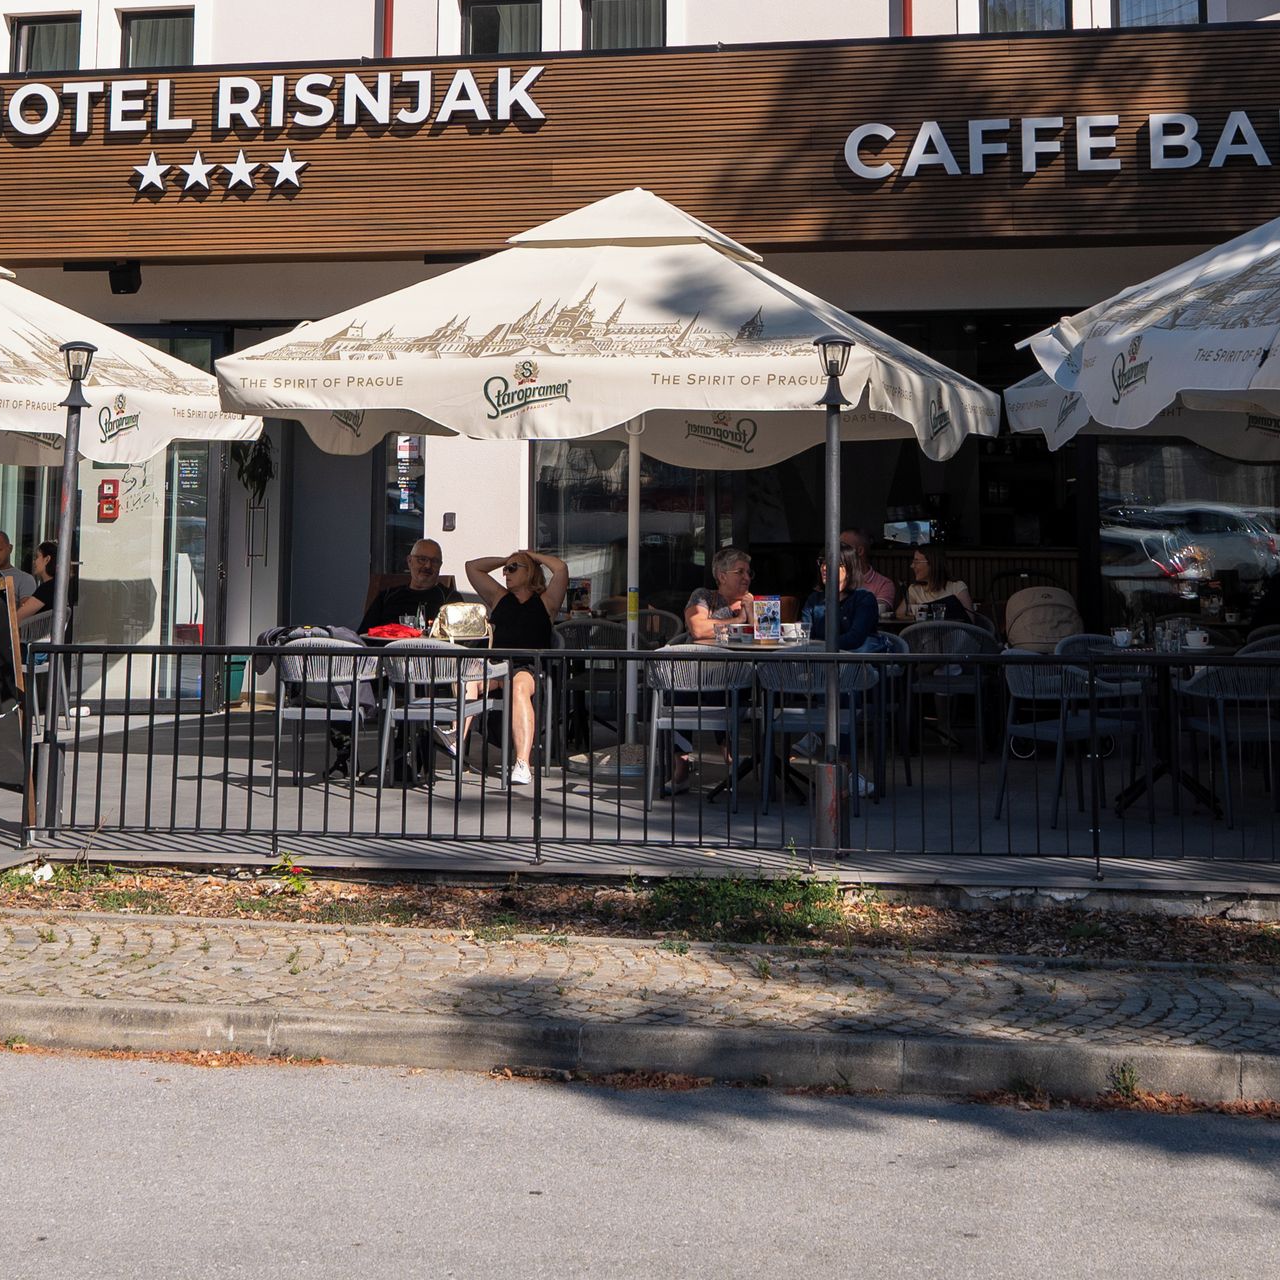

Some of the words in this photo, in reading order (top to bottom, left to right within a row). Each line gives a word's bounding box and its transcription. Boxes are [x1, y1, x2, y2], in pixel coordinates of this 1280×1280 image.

[217, 66, 546, 129] RISNJAK
[843, 114, 1121, 180] CAFFE
[1194, 348, 1214, 361] THE
[1213, 348, 1243, 362] SPIRIT
[240, 377, 267, 389] THE
[273, 377, 318, 389] SPIRIT
[322, 377, 341, 388] OF
[346, 376, 404, 388] PRAGUE
[651, 373, 681, 385] THE
[686, 373, 735, 386] SPIRIT
[740, 375, 761, 386] OF
[767, 373, 828, 386] PRAGUE
[483, 376, 571, 420] Staropramen
[12, 400, 23, 409] OF
[25, 399, 57, 411] PRAGUE
[172, 407, 185, 418] THE
[187, 408, 207, 419] SPIRIT
[208, 411, 218, 420] OF
[219, 409, 242, 420] PRAGU
